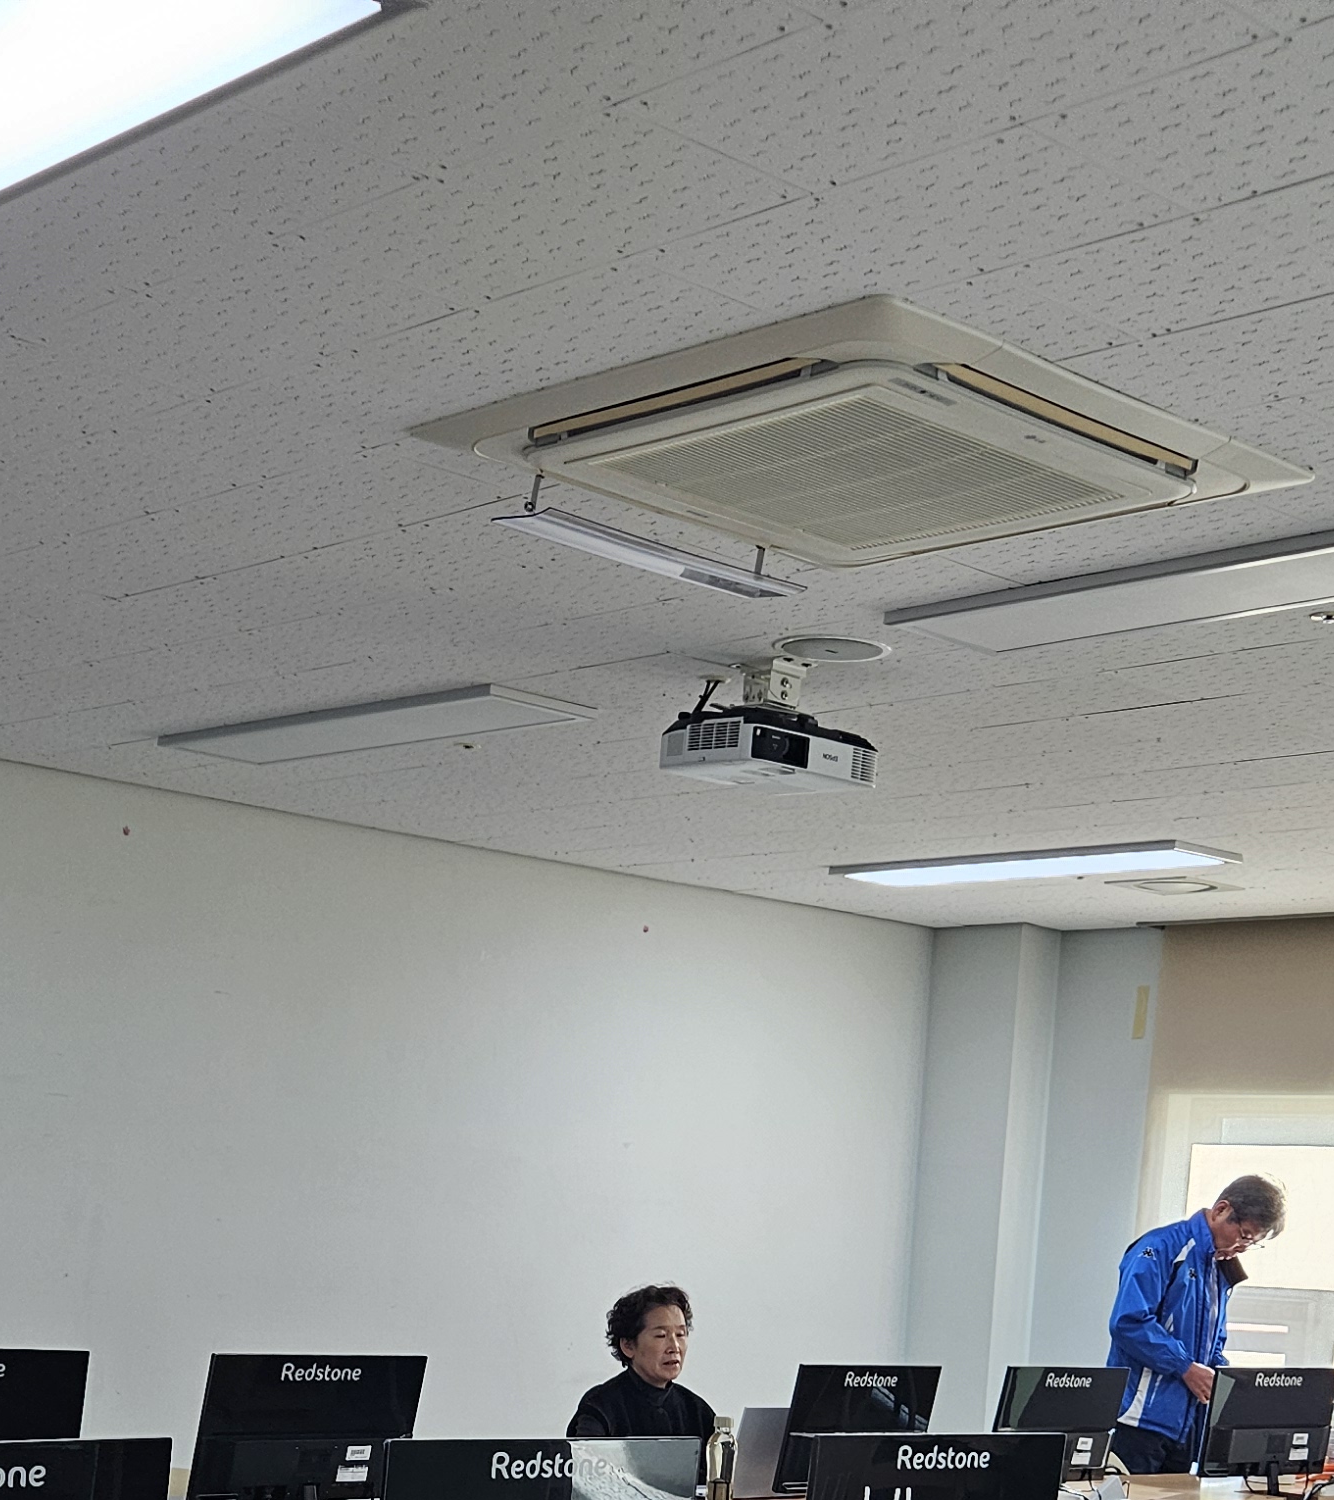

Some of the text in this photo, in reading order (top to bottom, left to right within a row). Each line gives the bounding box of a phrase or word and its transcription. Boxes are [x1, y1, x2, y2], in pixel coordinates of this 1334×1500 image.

[822, 752, 839, 763] EPSON
[281, 1362, 362, 1382] Redstone
[844, 1371, 899, 1388] Redstone
[1046, 1372, 1093, 1388] Redstone
[1254, 1372, 1303, 1387] Redstone
[491, 1451, 609, 1480] Redstone
[897, 1444, 991, 1470] Redstone
